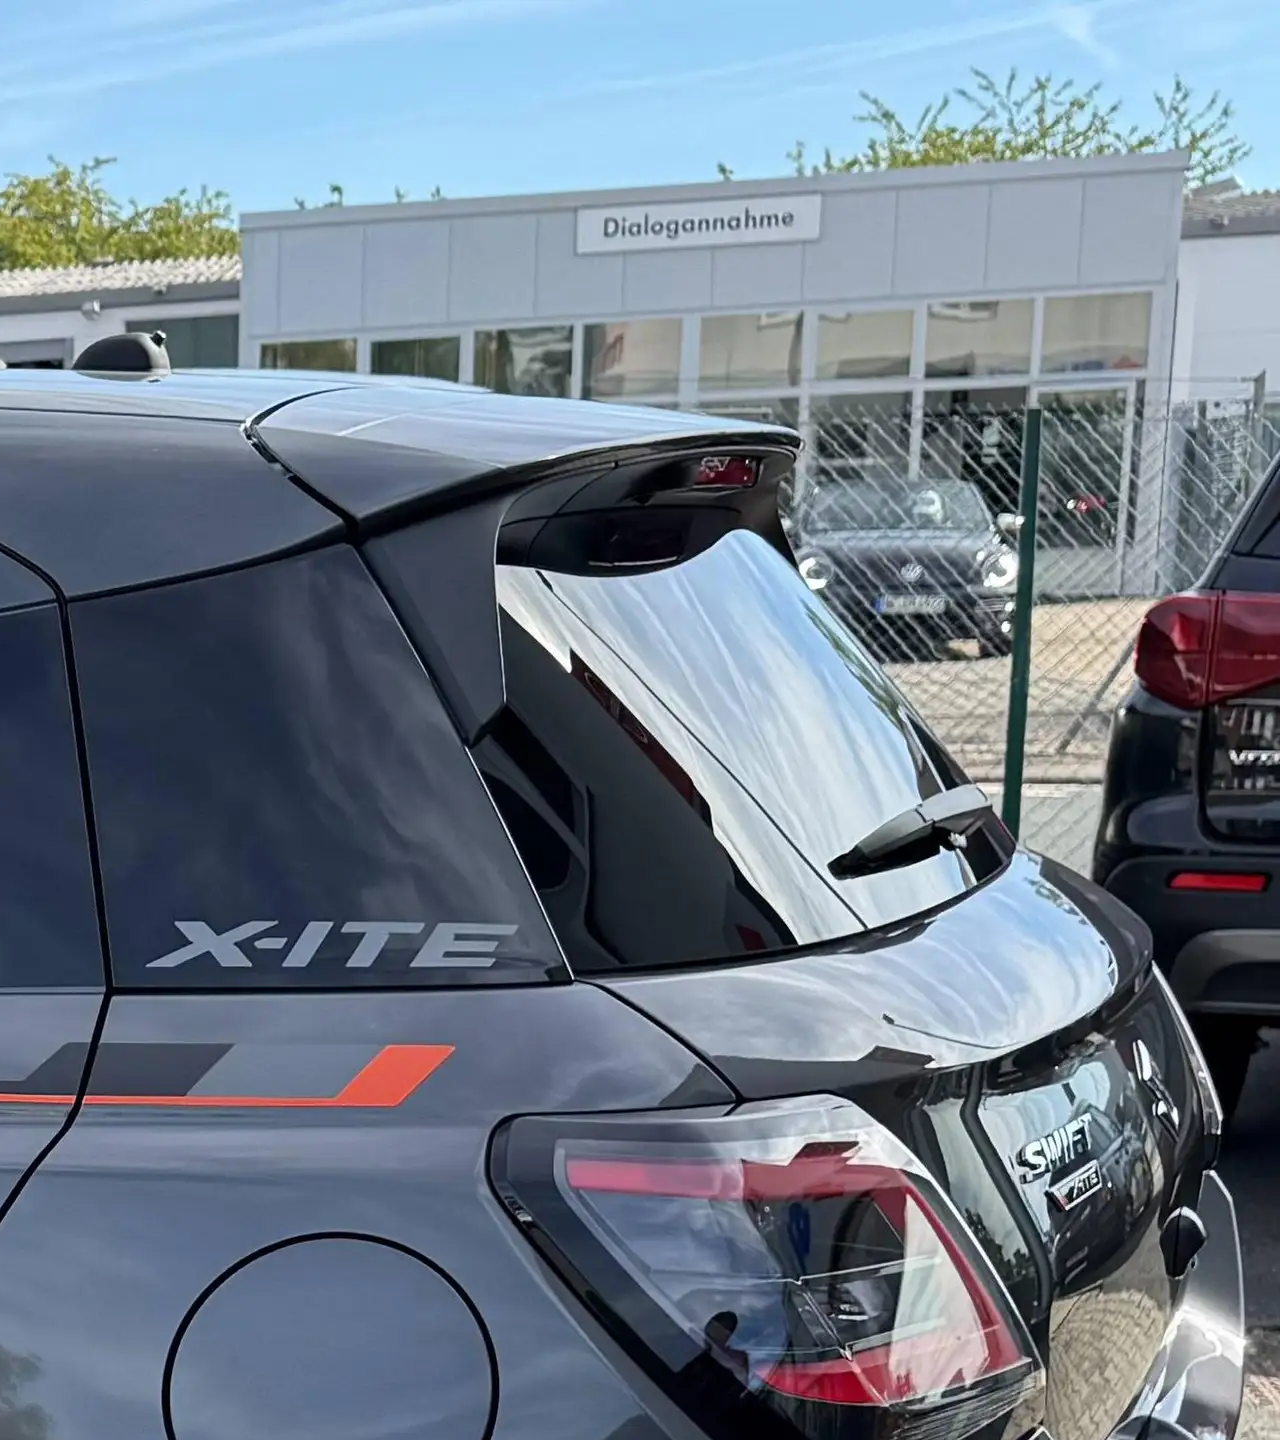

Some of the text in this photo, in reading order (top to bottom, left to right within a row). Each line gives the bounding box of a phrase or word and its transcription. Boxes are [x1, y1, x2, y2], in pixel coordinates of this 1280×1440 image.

[603, 206, 796, 240] Dialogannahme
[145, 921, 519, 967] X-ITE
[1018, 1112, 1093, 1184] SWIFT
